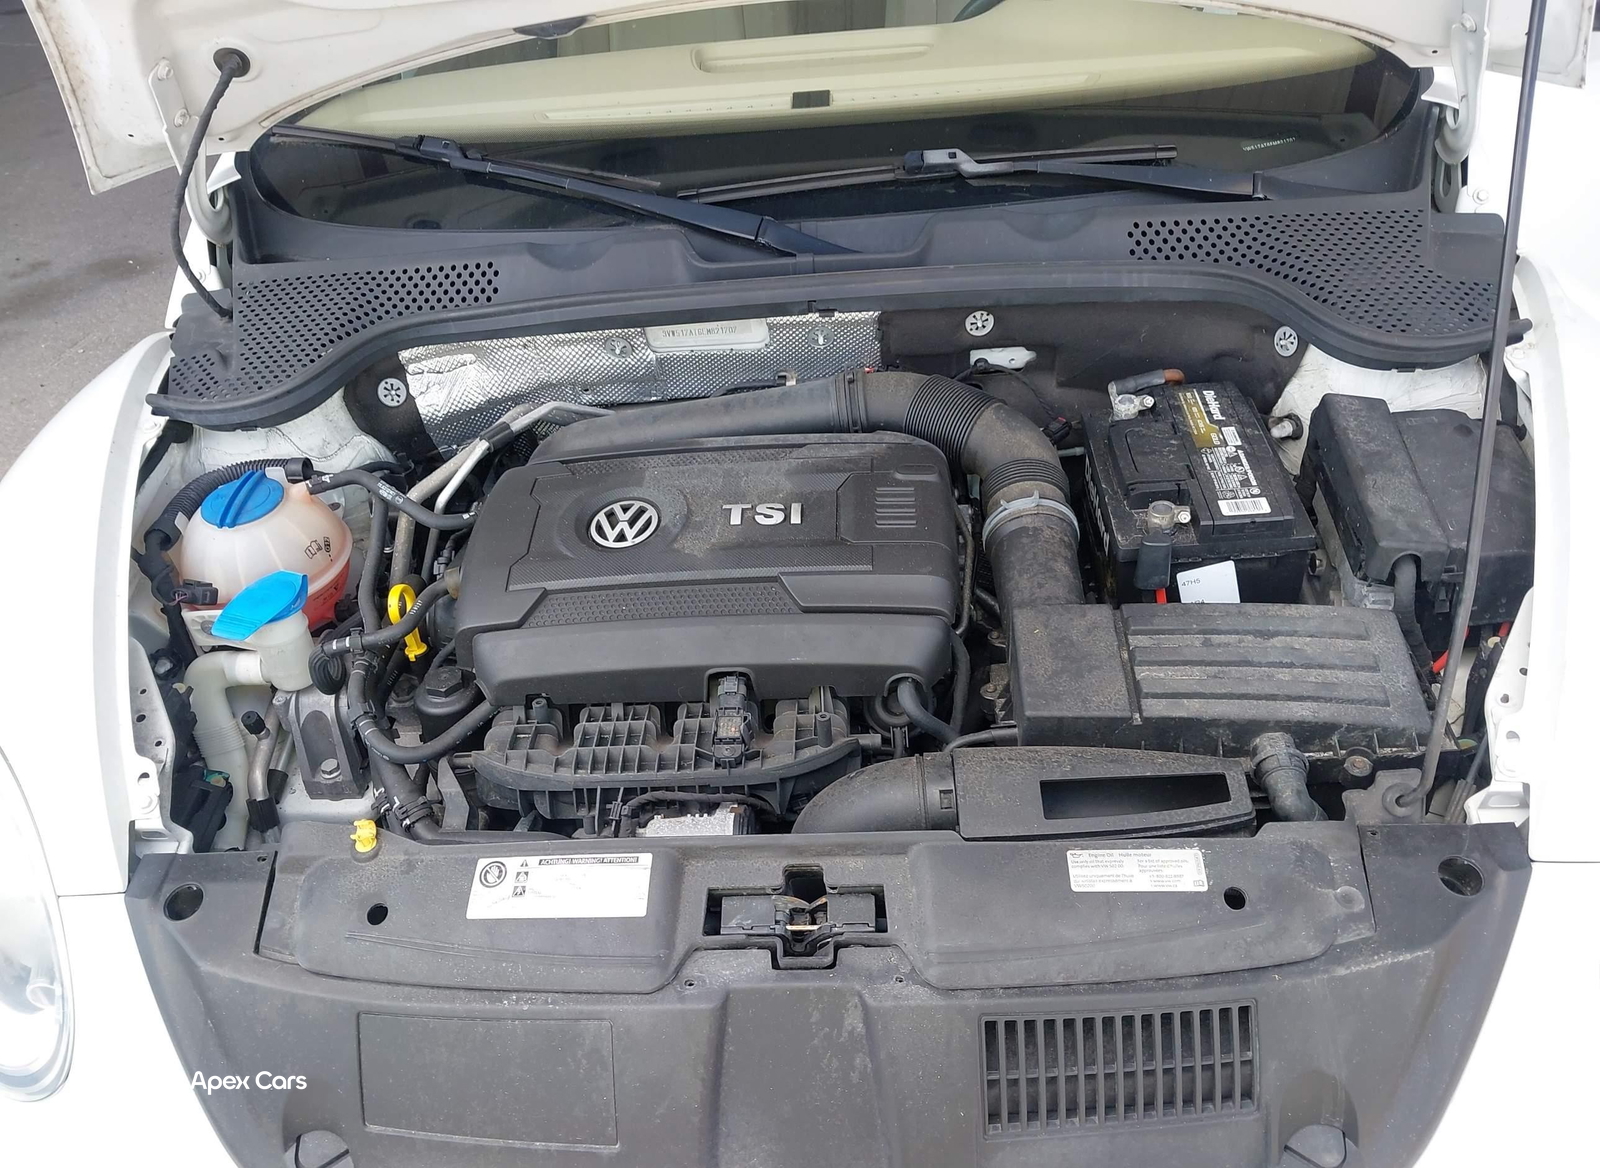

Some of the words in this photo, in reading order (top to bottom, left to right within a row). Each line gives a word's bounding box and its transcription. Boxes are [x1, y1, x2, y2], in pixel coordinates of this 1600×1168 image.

[1202, 390, 1226, 421] DieHard
[590, 500, 658, 548] VW
[722, 502, 802, 526] TSI
